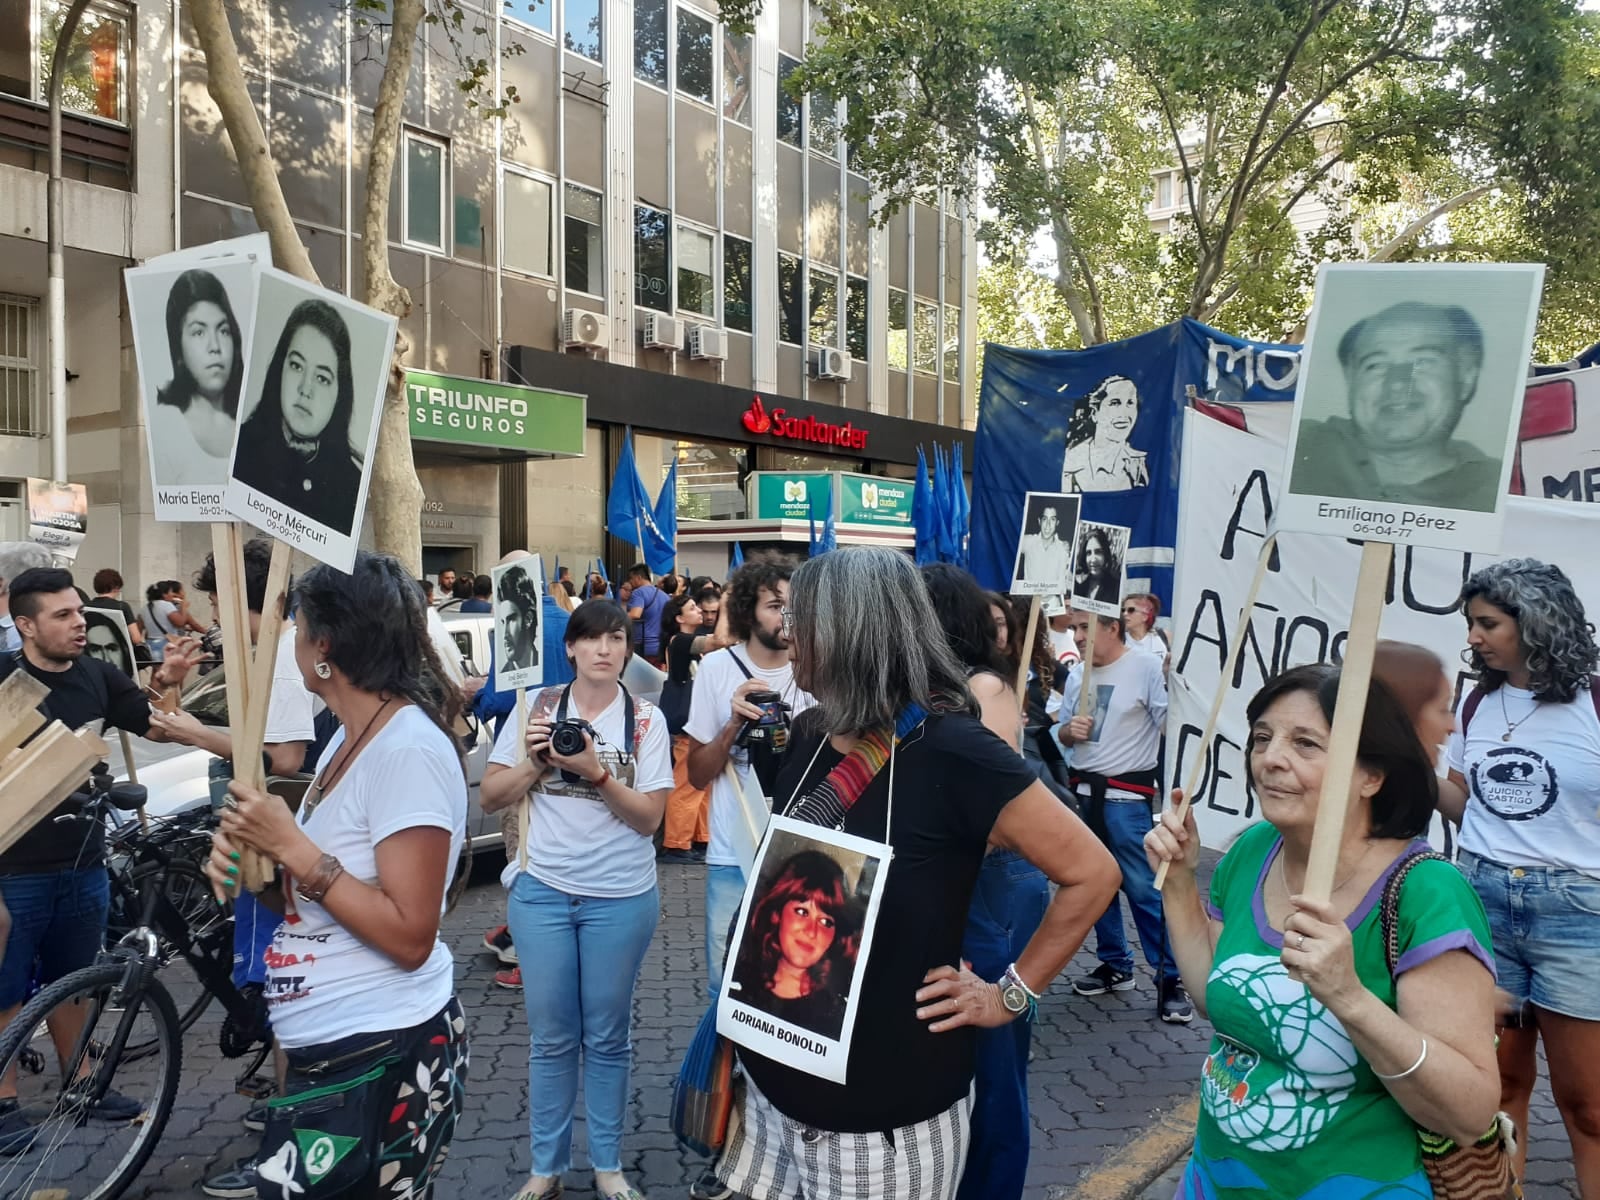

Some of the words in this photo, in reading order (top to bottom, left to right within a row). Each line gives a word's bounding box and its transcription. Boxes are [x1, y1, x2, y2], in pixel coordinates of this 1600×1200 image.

[409, 384, 528, 417] TRIUNFO
[416, 408, 525, 434] SEGUROS
[771, 408, 869, 449] Santander
[158, 491, 188, 505] María
[191, 491, 220, 505] Elena
[247, 493, 283, 522] Leonor
[285, 513, 328, 545] Mércuri
[1318, 502, 1396, 525] Emiliano
[1401, 511, 1456, 531] Pérez
[266, 519, 302, 544] 09-09-76
[1353, 523, 1413, 538] 06-04-77
[1487, 794, 1533, 805] CASTIGO
[1488, 787, 1523, 796] JUICIO
[731, 1009, 775, 1037] ADRIANA
[777, 1028, 828, 1057] BONOLDI
